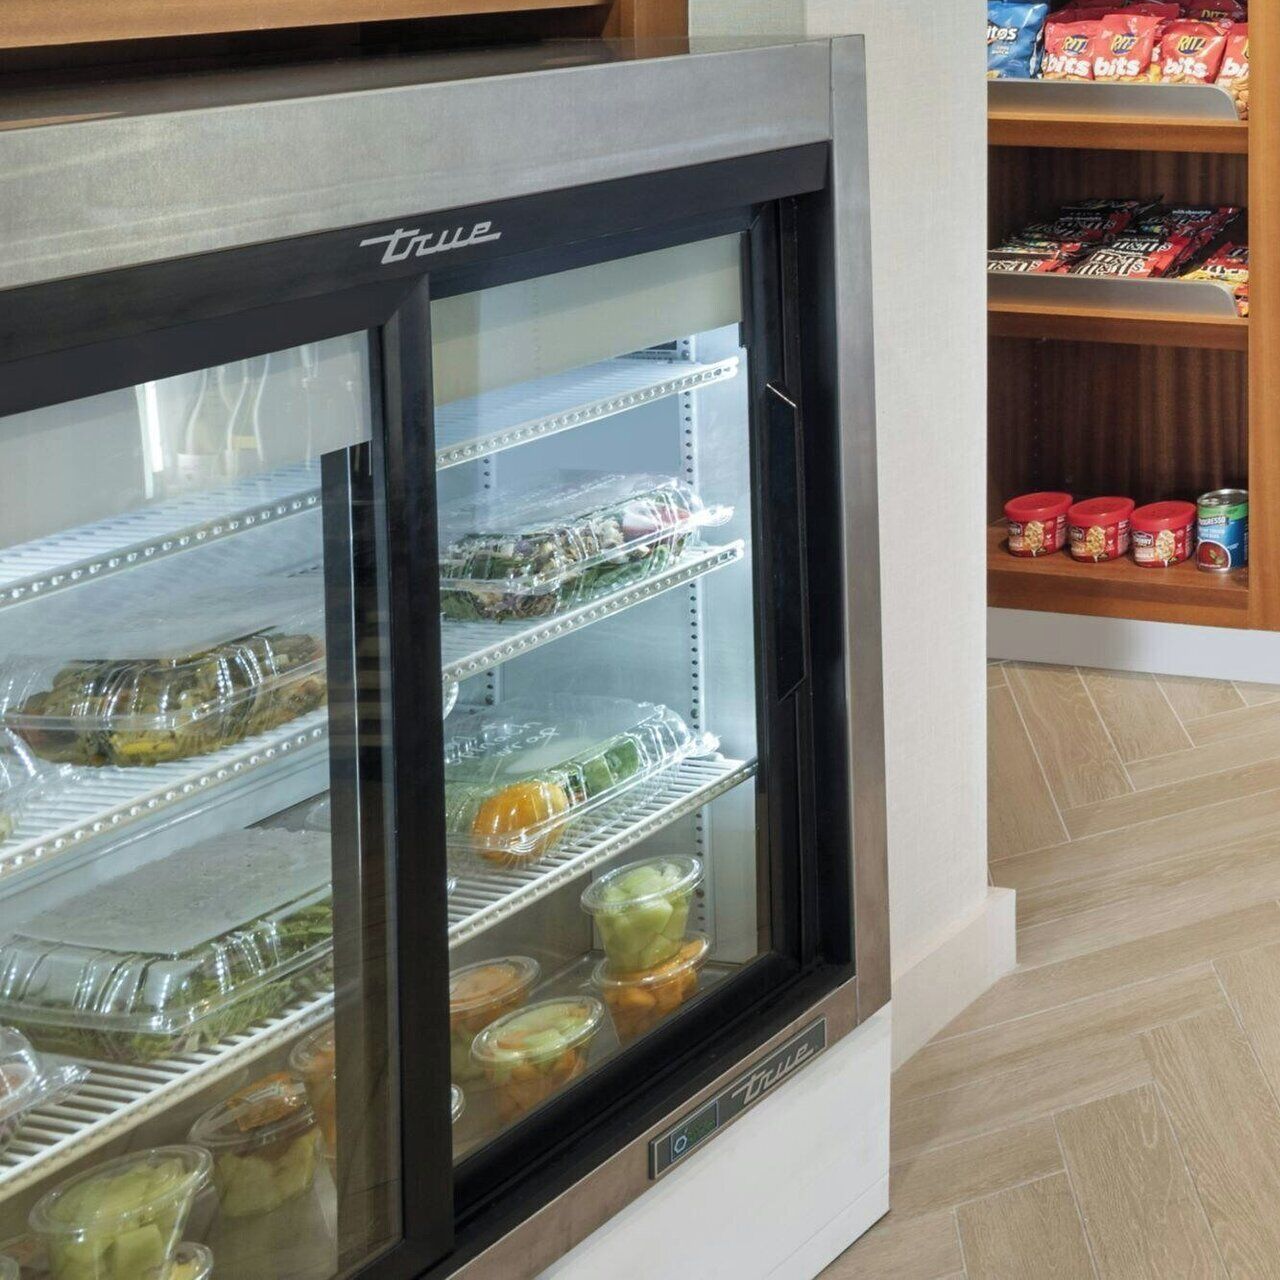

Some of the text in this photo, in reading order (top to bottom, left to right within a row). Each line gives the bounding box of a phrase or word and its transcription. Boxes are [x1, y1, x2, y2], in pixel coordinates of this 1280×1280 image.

[1177, 35, 1207, 51] RITZ
[1094, 57, 1142, 76] bits
[1165, 59, 1207, 77] bits
[360, 220, 501, 265] true
